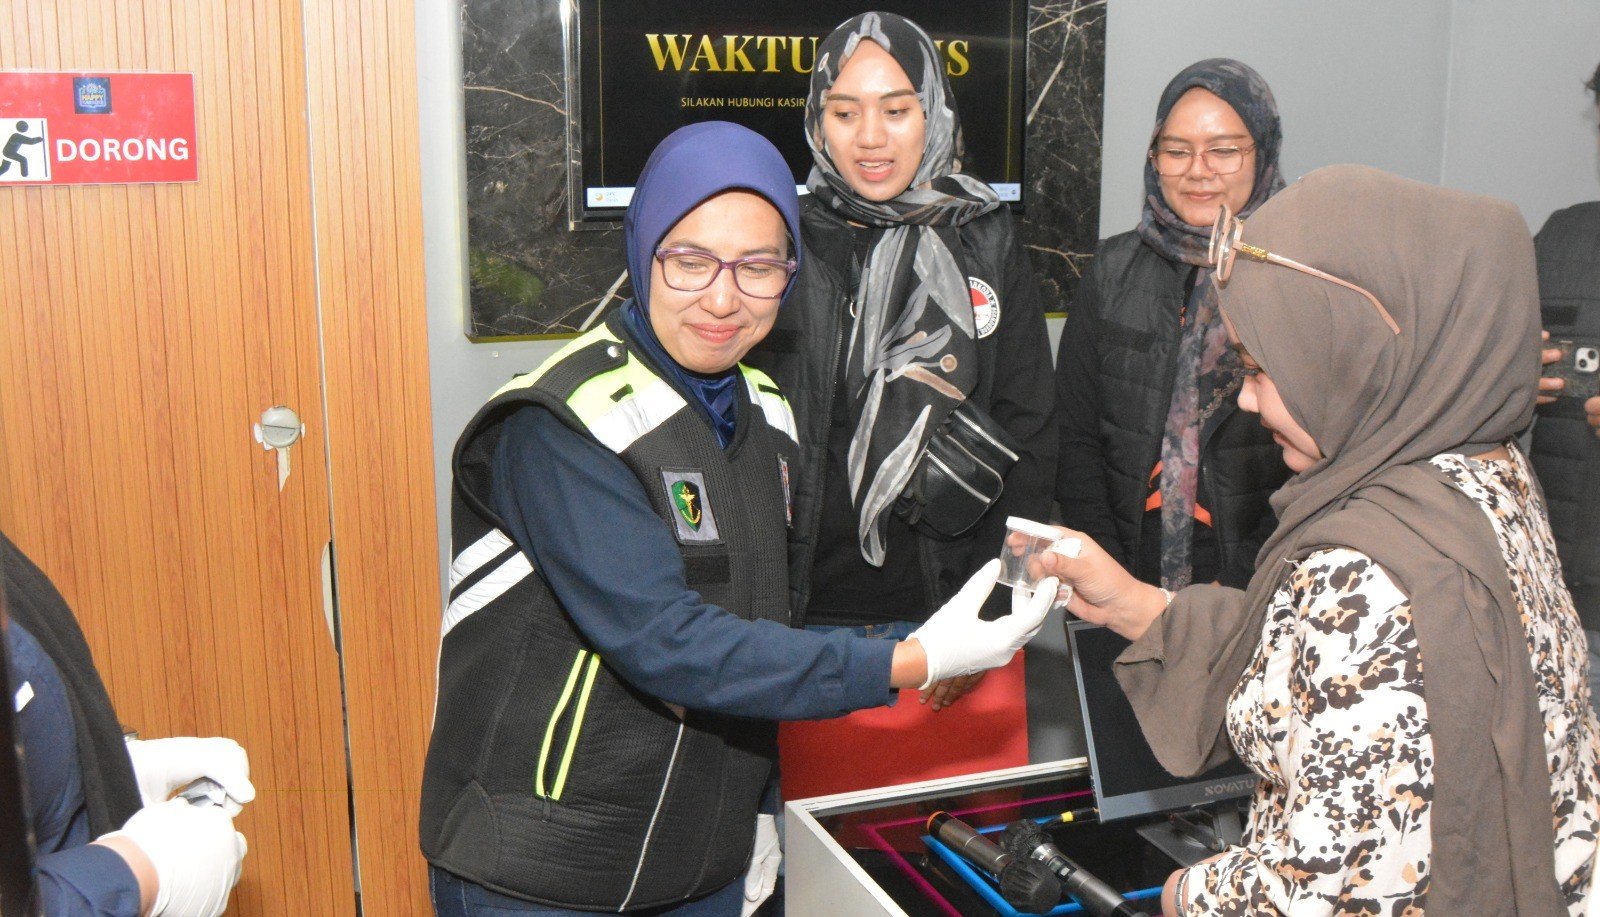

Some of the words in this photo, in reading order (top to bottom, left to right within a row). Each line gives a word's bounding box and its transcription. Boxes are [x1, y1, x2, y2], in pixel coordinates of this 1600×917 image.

[645, 33, 819, 74] WAKTU
[681, 97, 725, 108] SILAKAN
[728, 97, 774, 108] HUBUNGI
[777, 97, 806, 108] KASIR
[56, 137, 189, 162] DORONG
